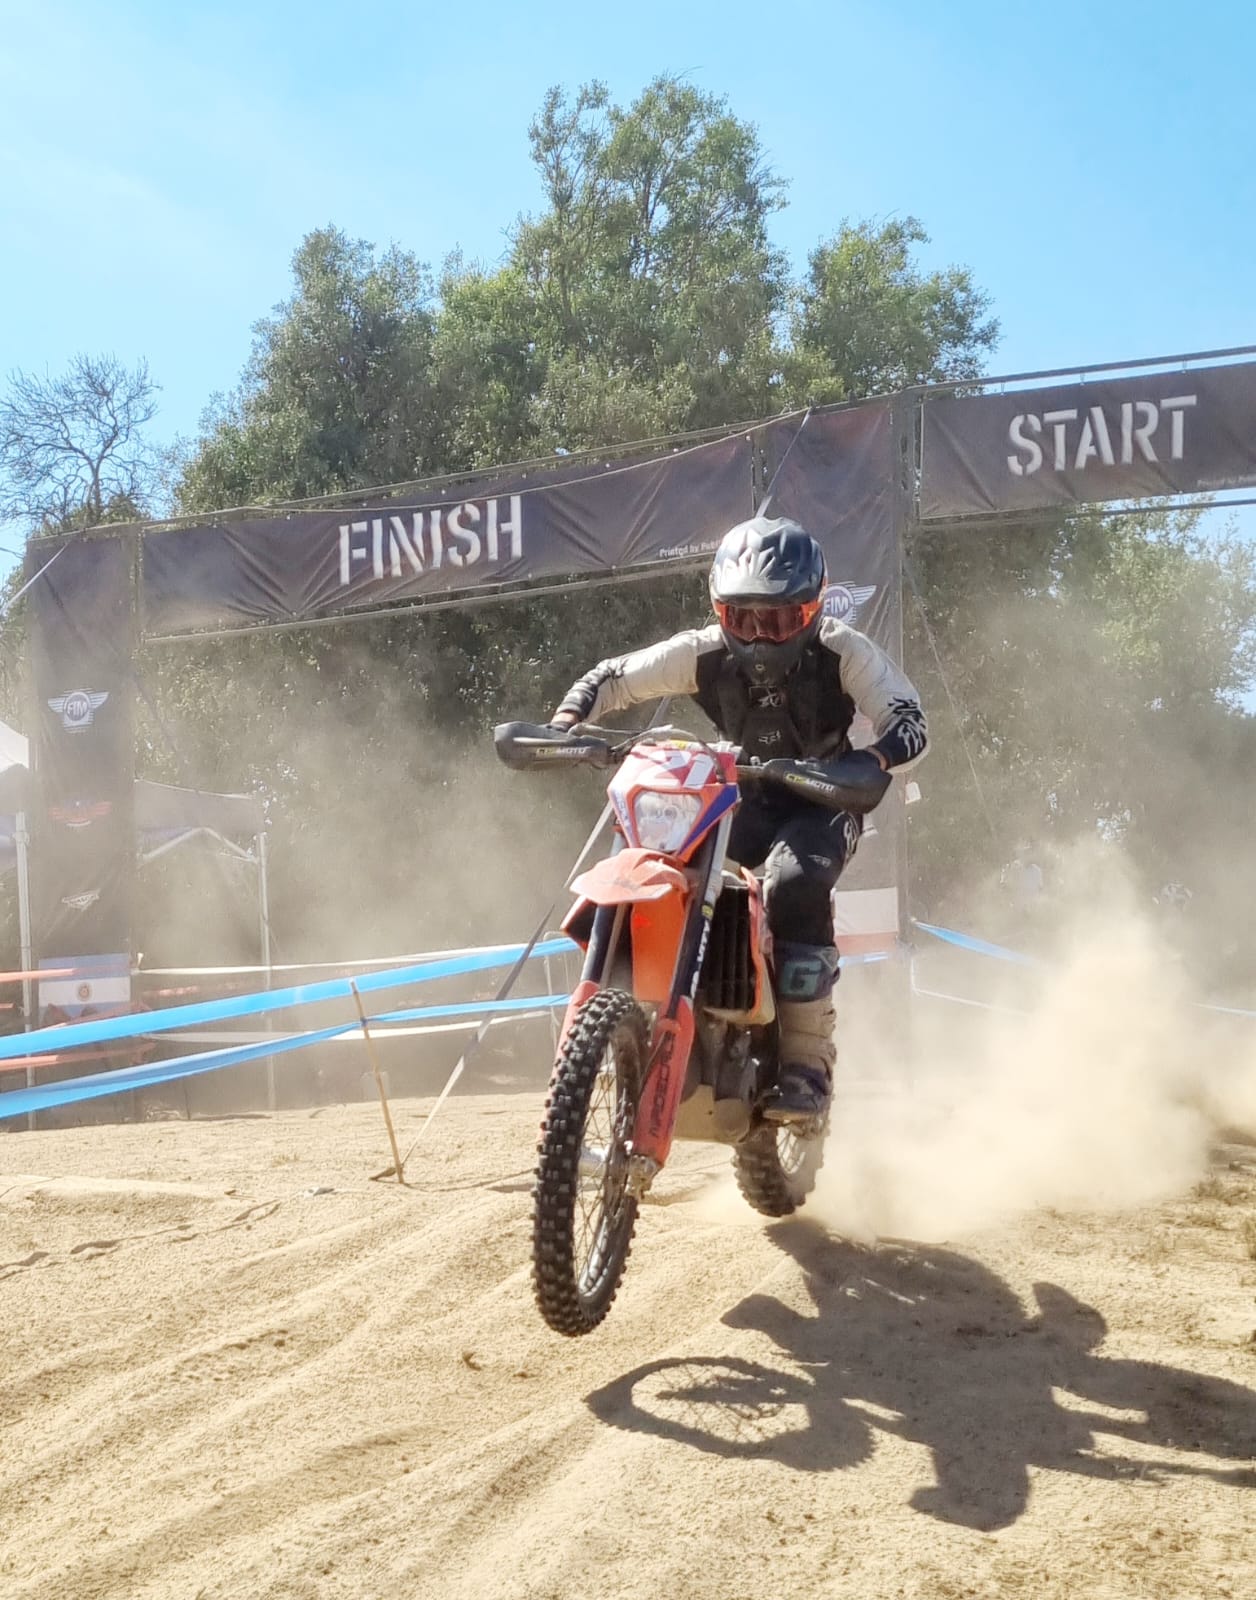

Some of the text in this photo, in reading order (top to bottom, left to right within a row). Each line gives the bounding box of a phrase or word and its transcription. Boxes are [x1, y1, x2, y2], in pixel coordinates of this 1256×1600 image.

[1007, 395, 1198, 476] START
[338, 494, 523, 586] FINISH
[824, 596, 849, 615] FIM
[67, 700, 88, 717] FIM
